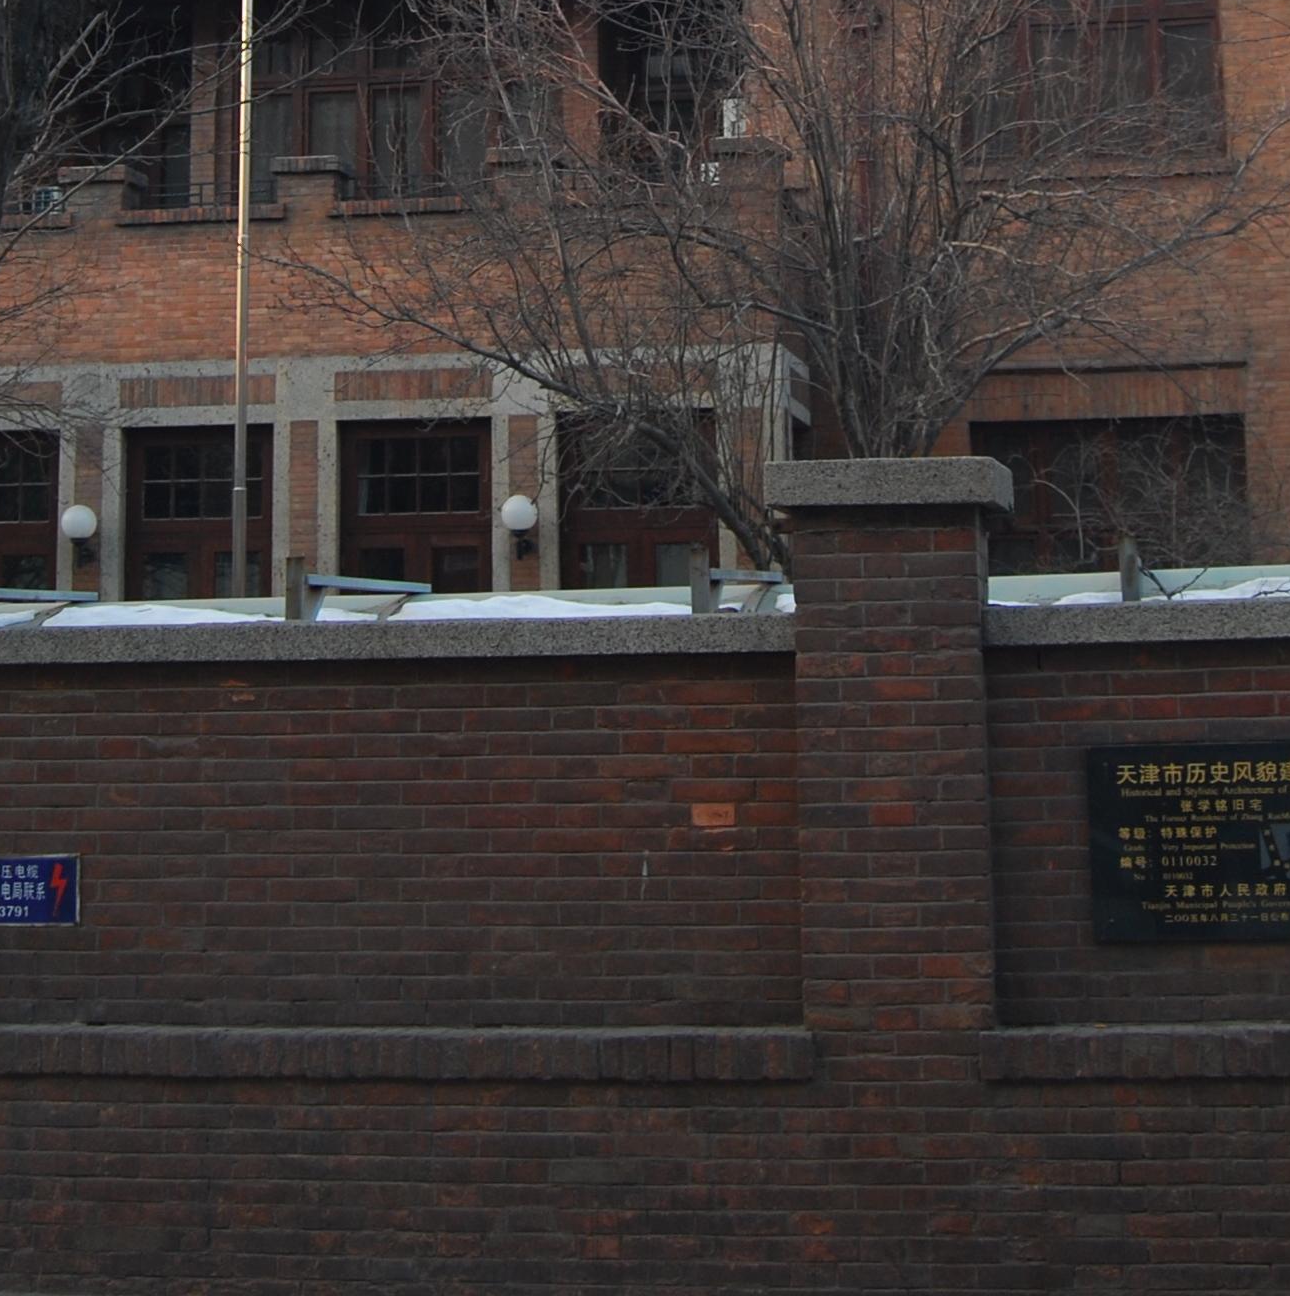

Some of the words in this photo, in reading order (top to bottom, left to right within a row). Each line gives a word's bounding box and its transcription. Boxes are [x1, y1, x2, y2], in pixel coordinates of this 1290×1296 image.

[1121, 787, 1162, 798] Historical
[1166, 787, 1181, 796] and
[1222, 785, 1275, 796] Architecture
[1278, 785, 1288, 794] of
[1180, 798, 1263, 813] 张学铭旧宅
[1241, 812, 1263, 822] Zhang
[1161, 825, 1218, 840] 特殊保护
[1161, 855, 1218, 867] 0110032
[1165, 883, 1288, 898] 天津市人民政府
[1142, 901, 1172, 911] Tianjin
[1176, 900, 1218, 911] Municipal
